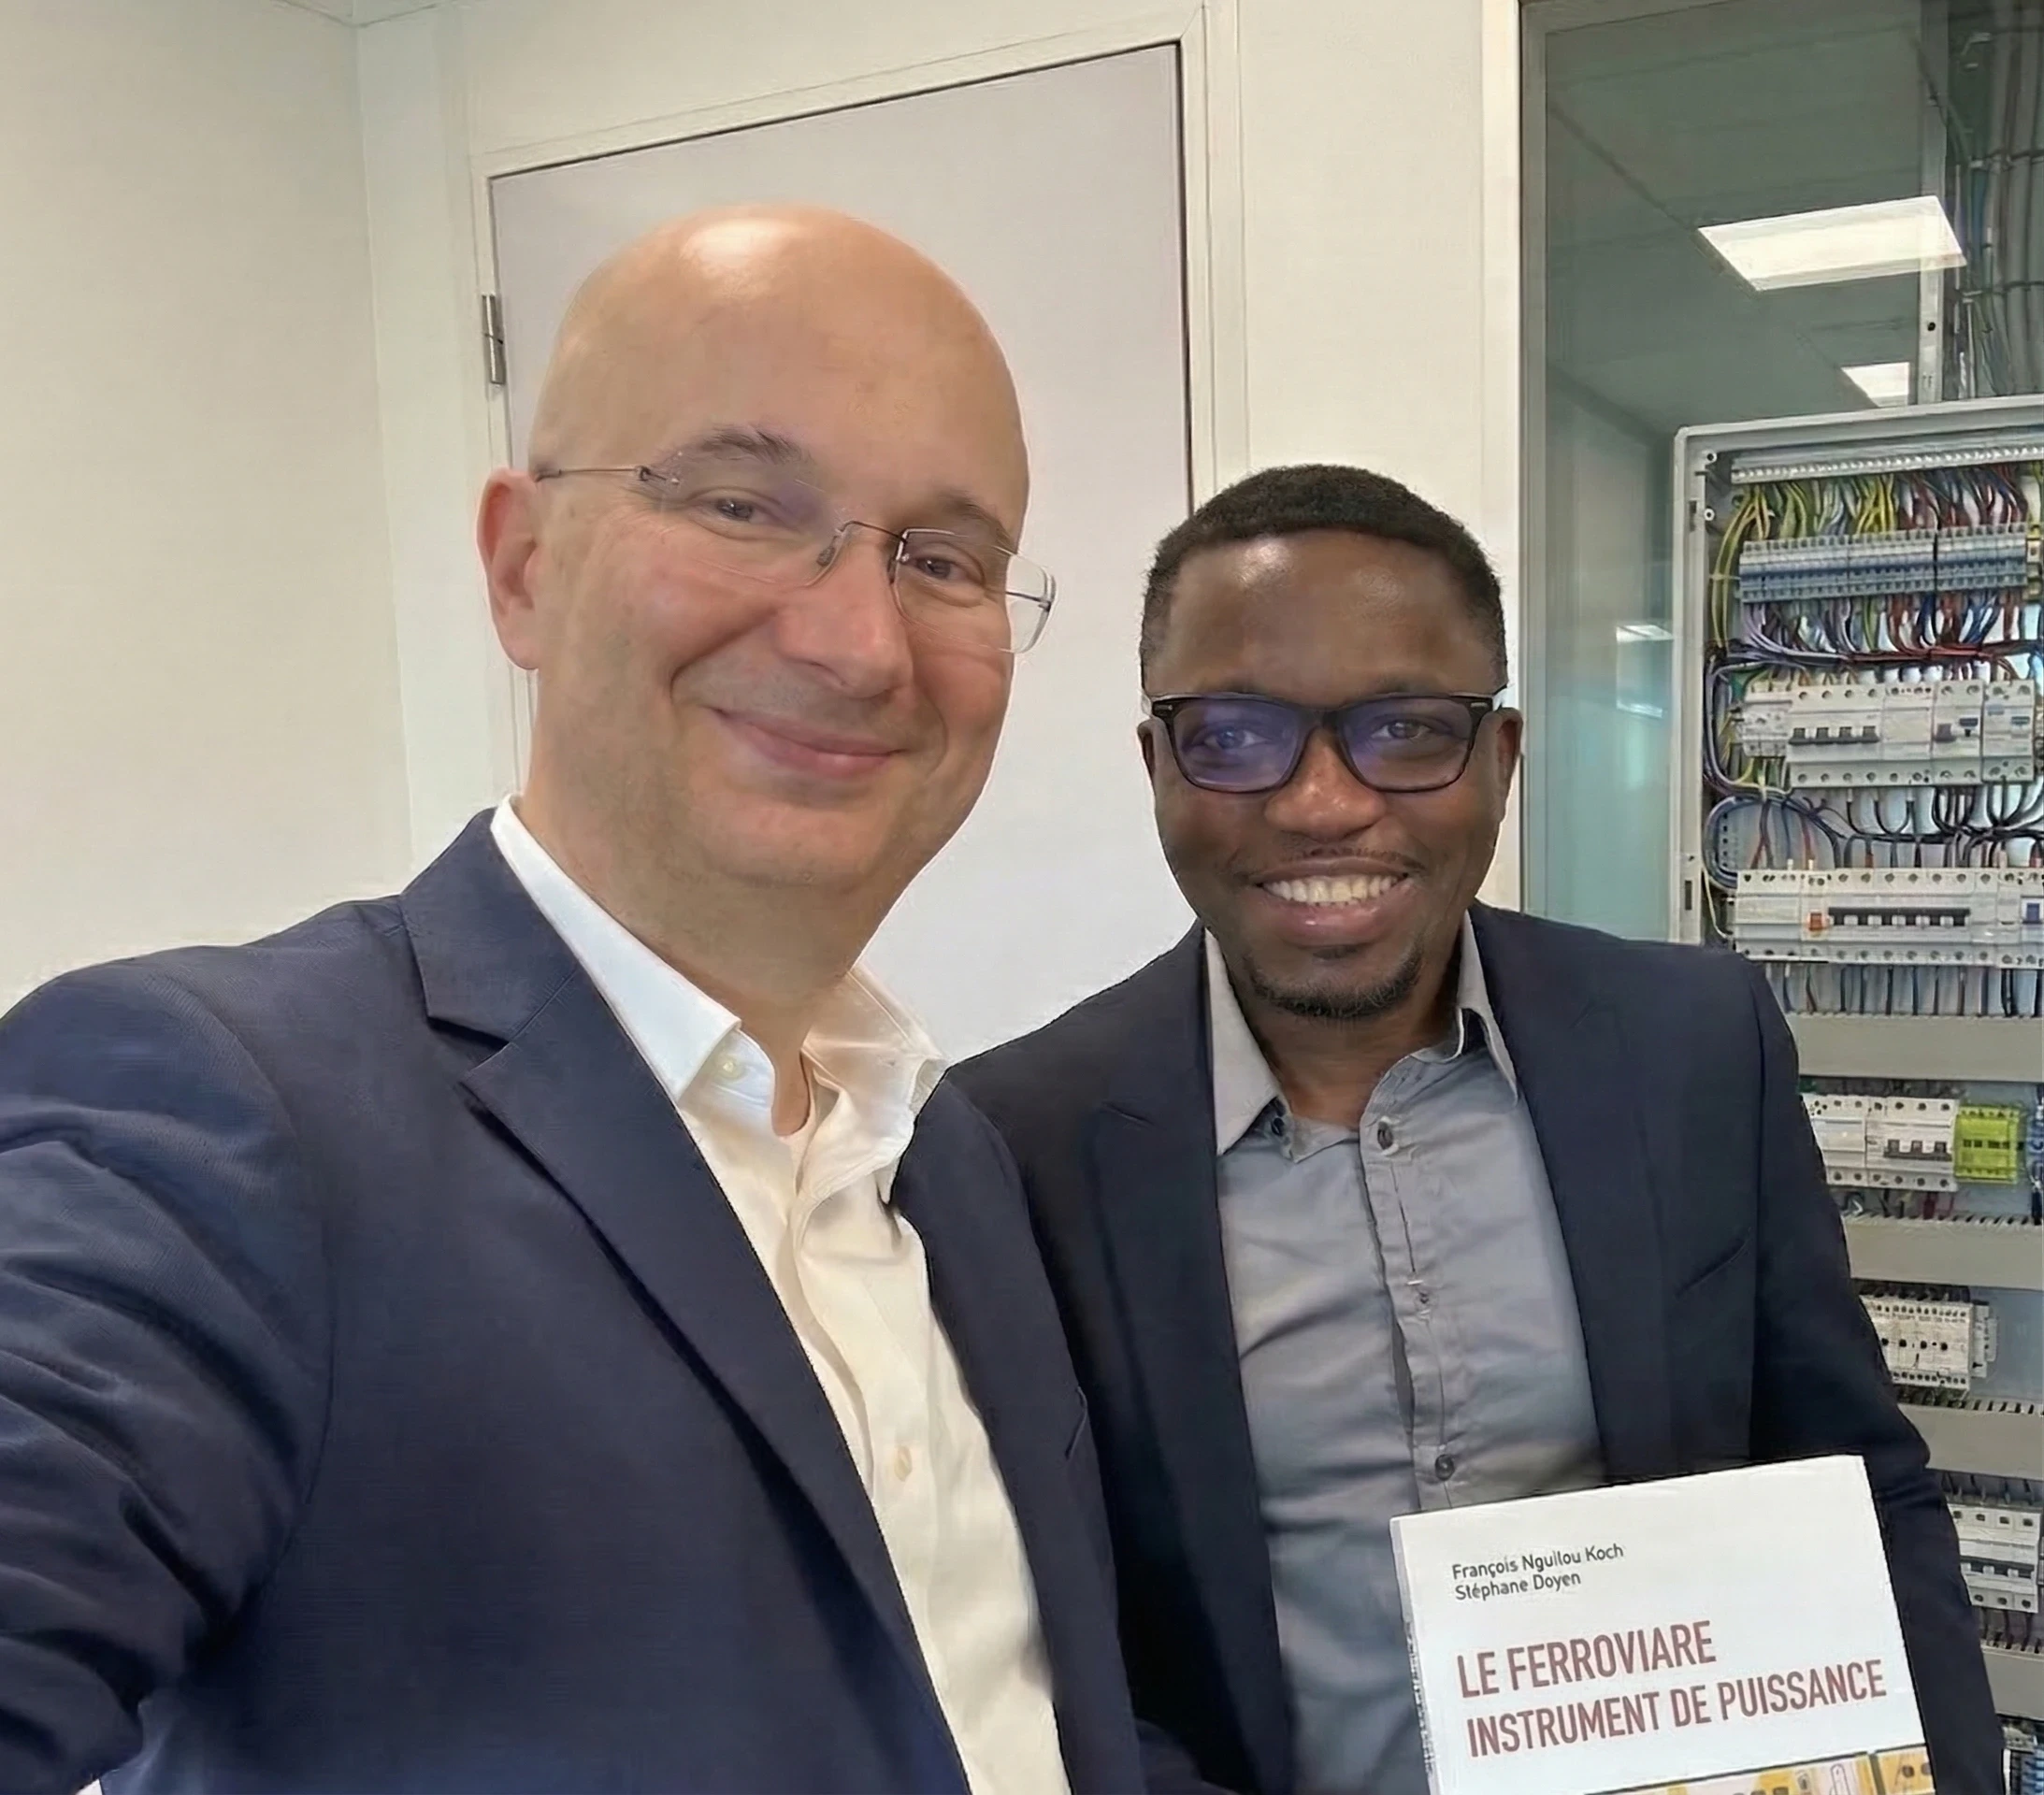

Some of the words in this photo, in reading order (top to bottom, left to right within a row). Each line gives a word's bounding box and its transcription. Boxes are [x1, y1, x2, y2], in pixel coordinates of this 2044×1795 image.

[1451, 1557, 1519, 1580] François
[1585, 1543, 1624, 1562] Koch
[1455, 1580, 1529, 1601] Stéphane
[1533, 1572, 1581, 1592] Doyen
[1457, 1651, 1500, 1699] LE
[1506, 1619, 1717, 1691] FERROVIARE
[1466, 1691, 1660, 1758] INSTRUMENT
[1669, 1684, 1712, 1728] DE
[1717, 1659, 1887, 1721] PUISSANCE
